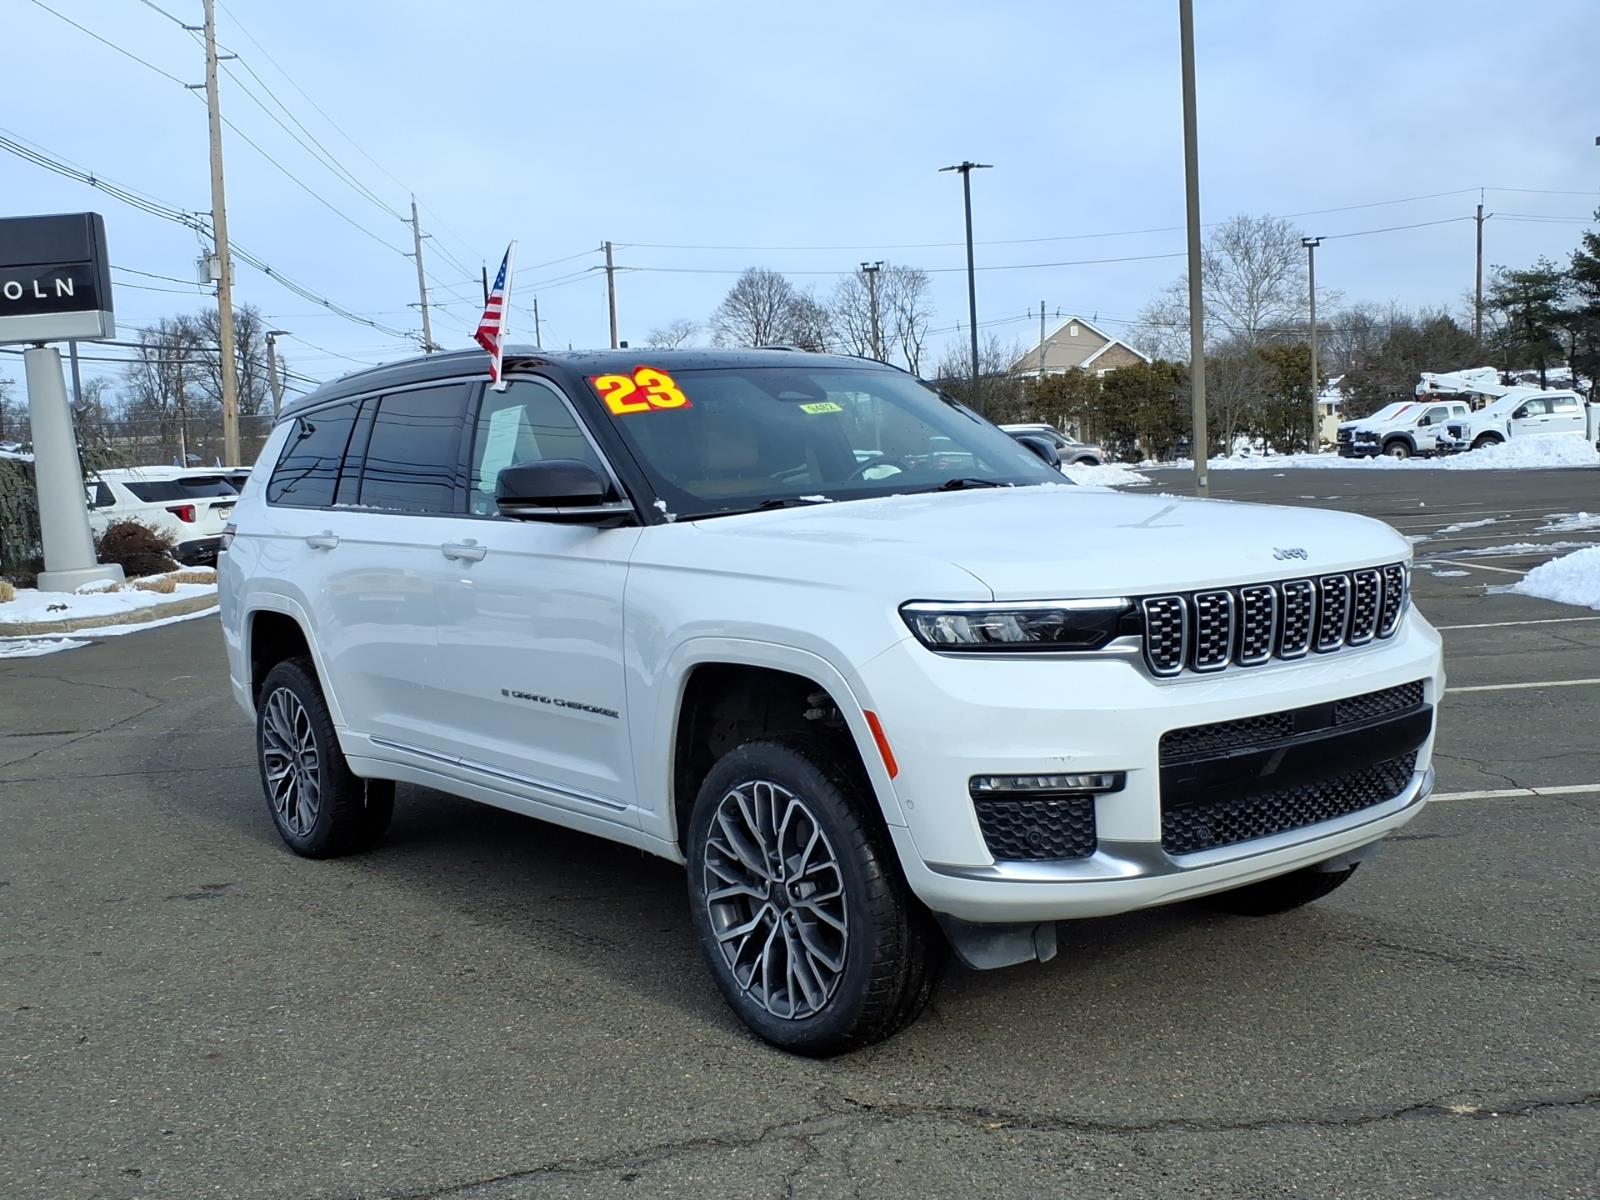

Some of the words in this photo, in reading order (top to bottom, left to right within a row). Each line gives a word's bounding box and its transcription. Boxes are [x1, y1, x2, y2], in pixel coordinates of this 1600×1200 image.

[595, 368, 686, 415] 23
[1272, 547, 1308, 561] Jeep
[511, 690, 552, 705] GRAND
[553, 698, 619, 719] CHEROKEE
